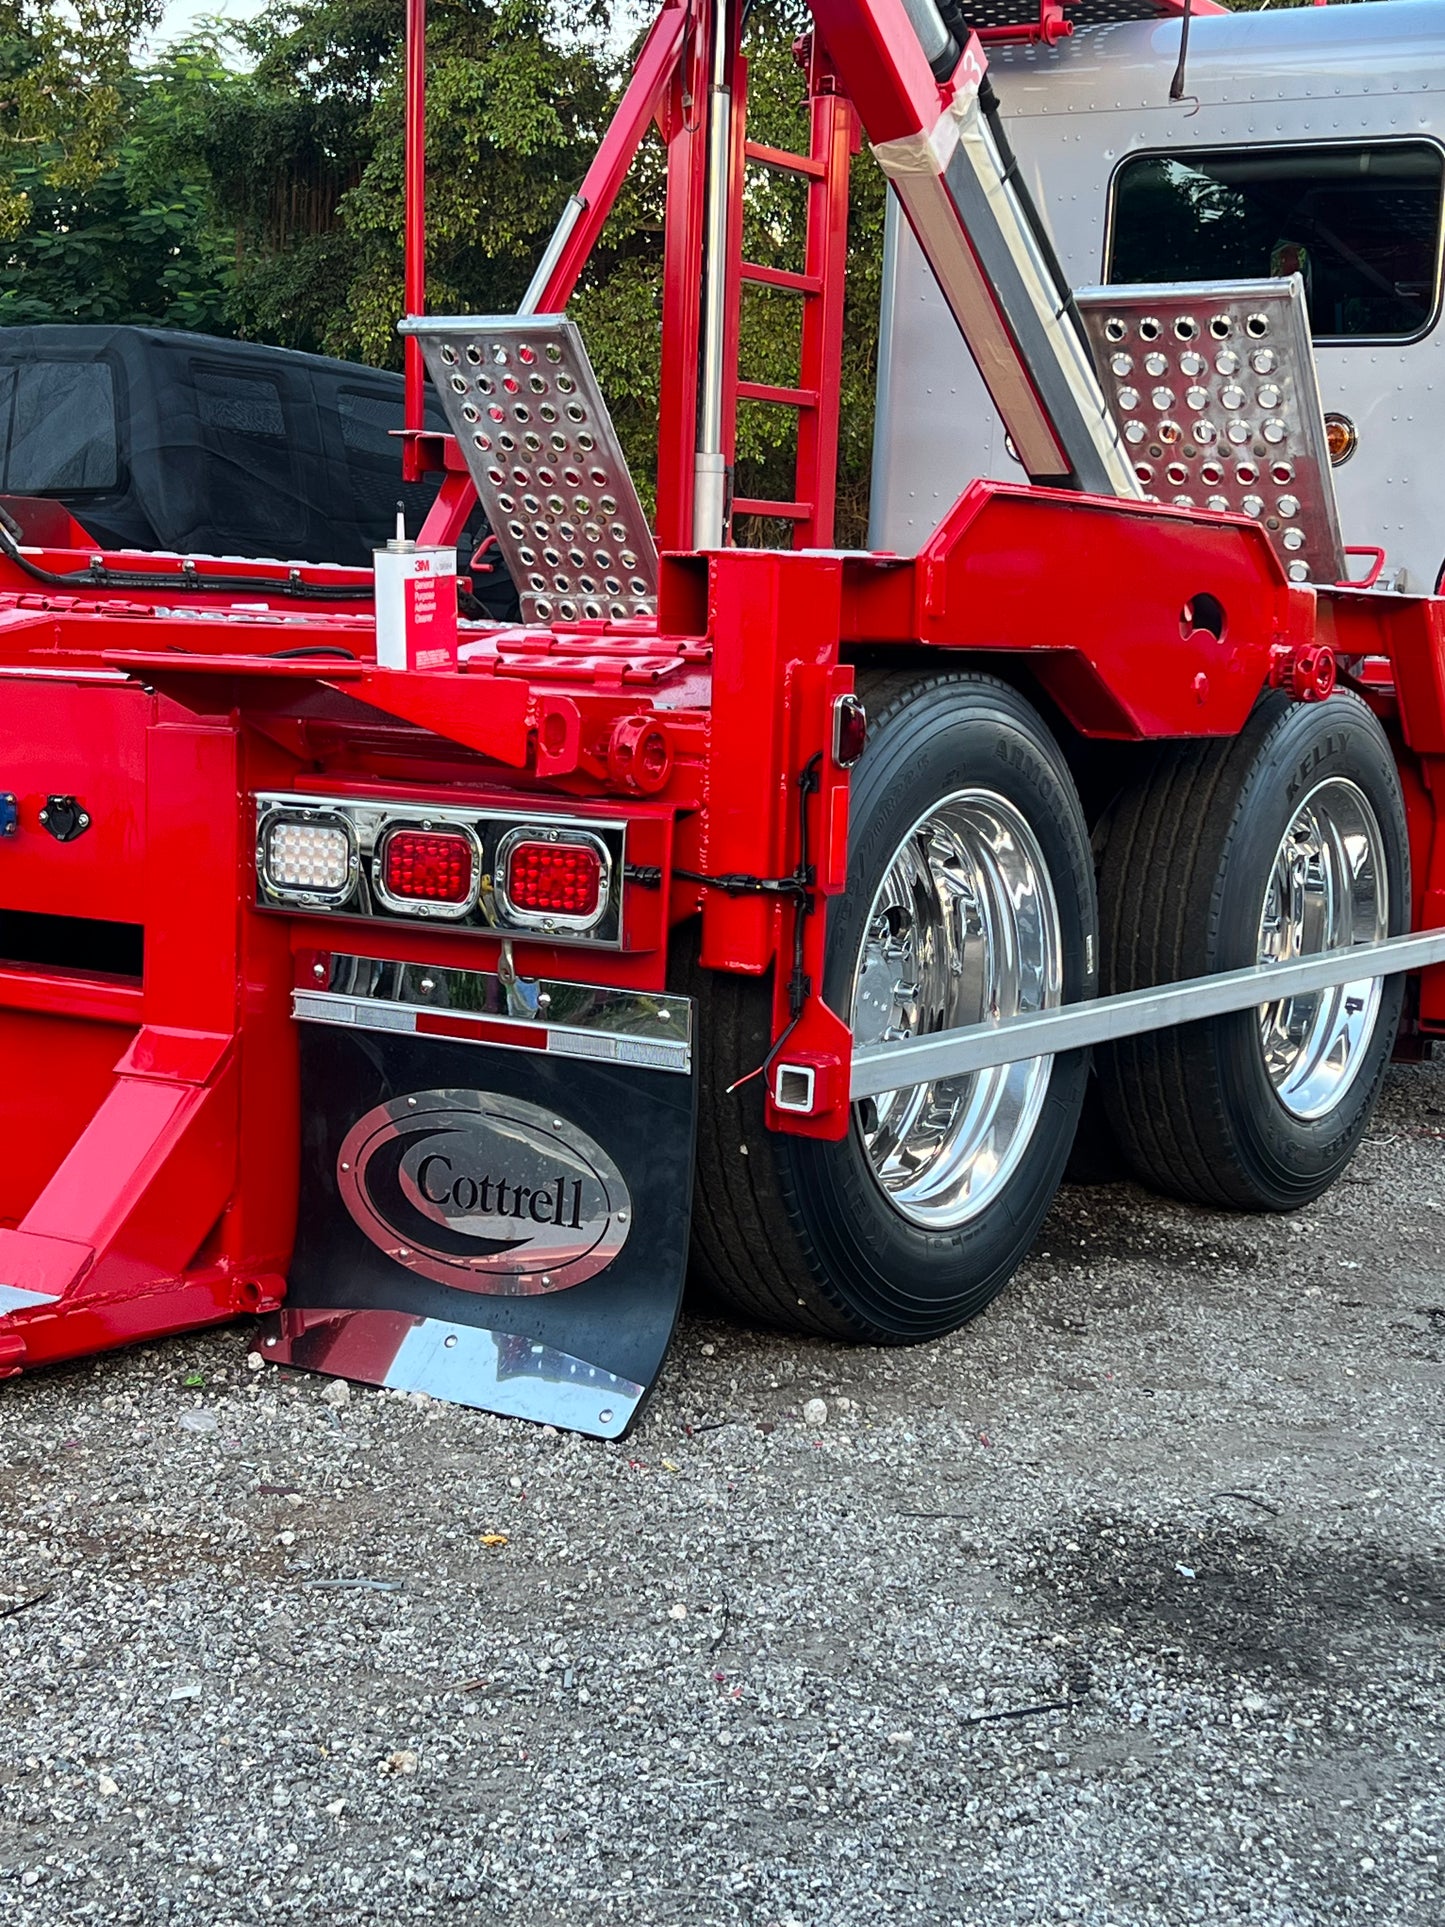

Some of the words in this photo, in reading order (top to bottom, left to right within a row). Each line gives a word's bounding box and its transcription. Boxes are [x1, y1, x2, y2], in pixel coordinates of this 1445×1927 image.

[415, 560, 430, 571] 3M
[414, 579, 435, 590] General
[414, 591, 435, 602] Purpose
[414, 602, 436, 613] Adhesive
[414, 614, 433, 624] Cleaner
[1286, 730, 1351, 804] KELLY
[416, 1155, 584, 1231] Cottrell
